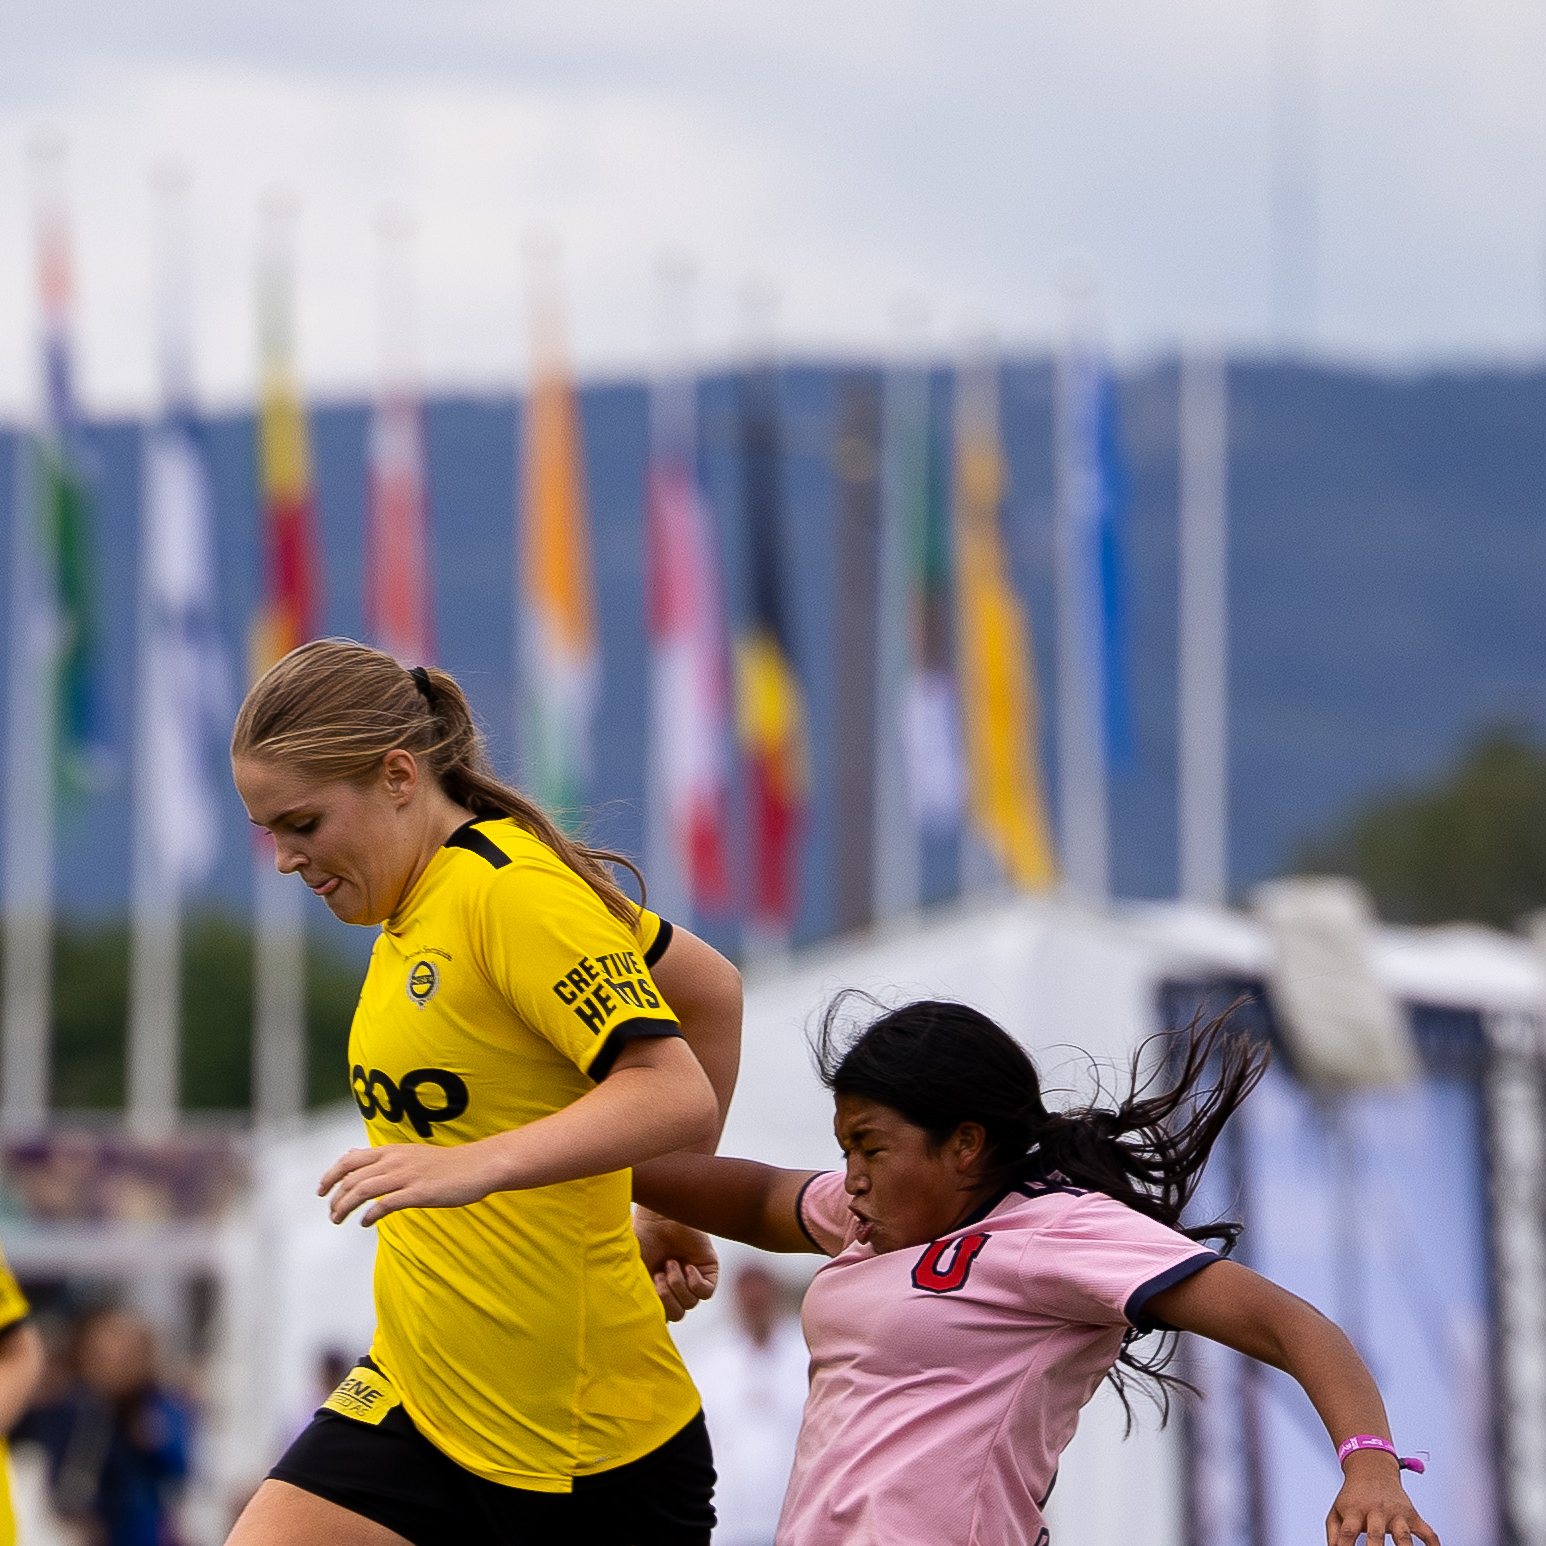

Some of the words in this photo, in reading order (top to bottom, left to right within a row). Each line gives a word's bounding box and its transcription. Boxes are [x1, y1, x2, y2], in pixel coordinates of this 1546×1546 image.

[553, 951, 642, 1005] CRETIVE
[573, 978, 660, 1036] HEDS
[353, 1064, 470, 1138] oop
[911, 1233, 991, 1293] U
